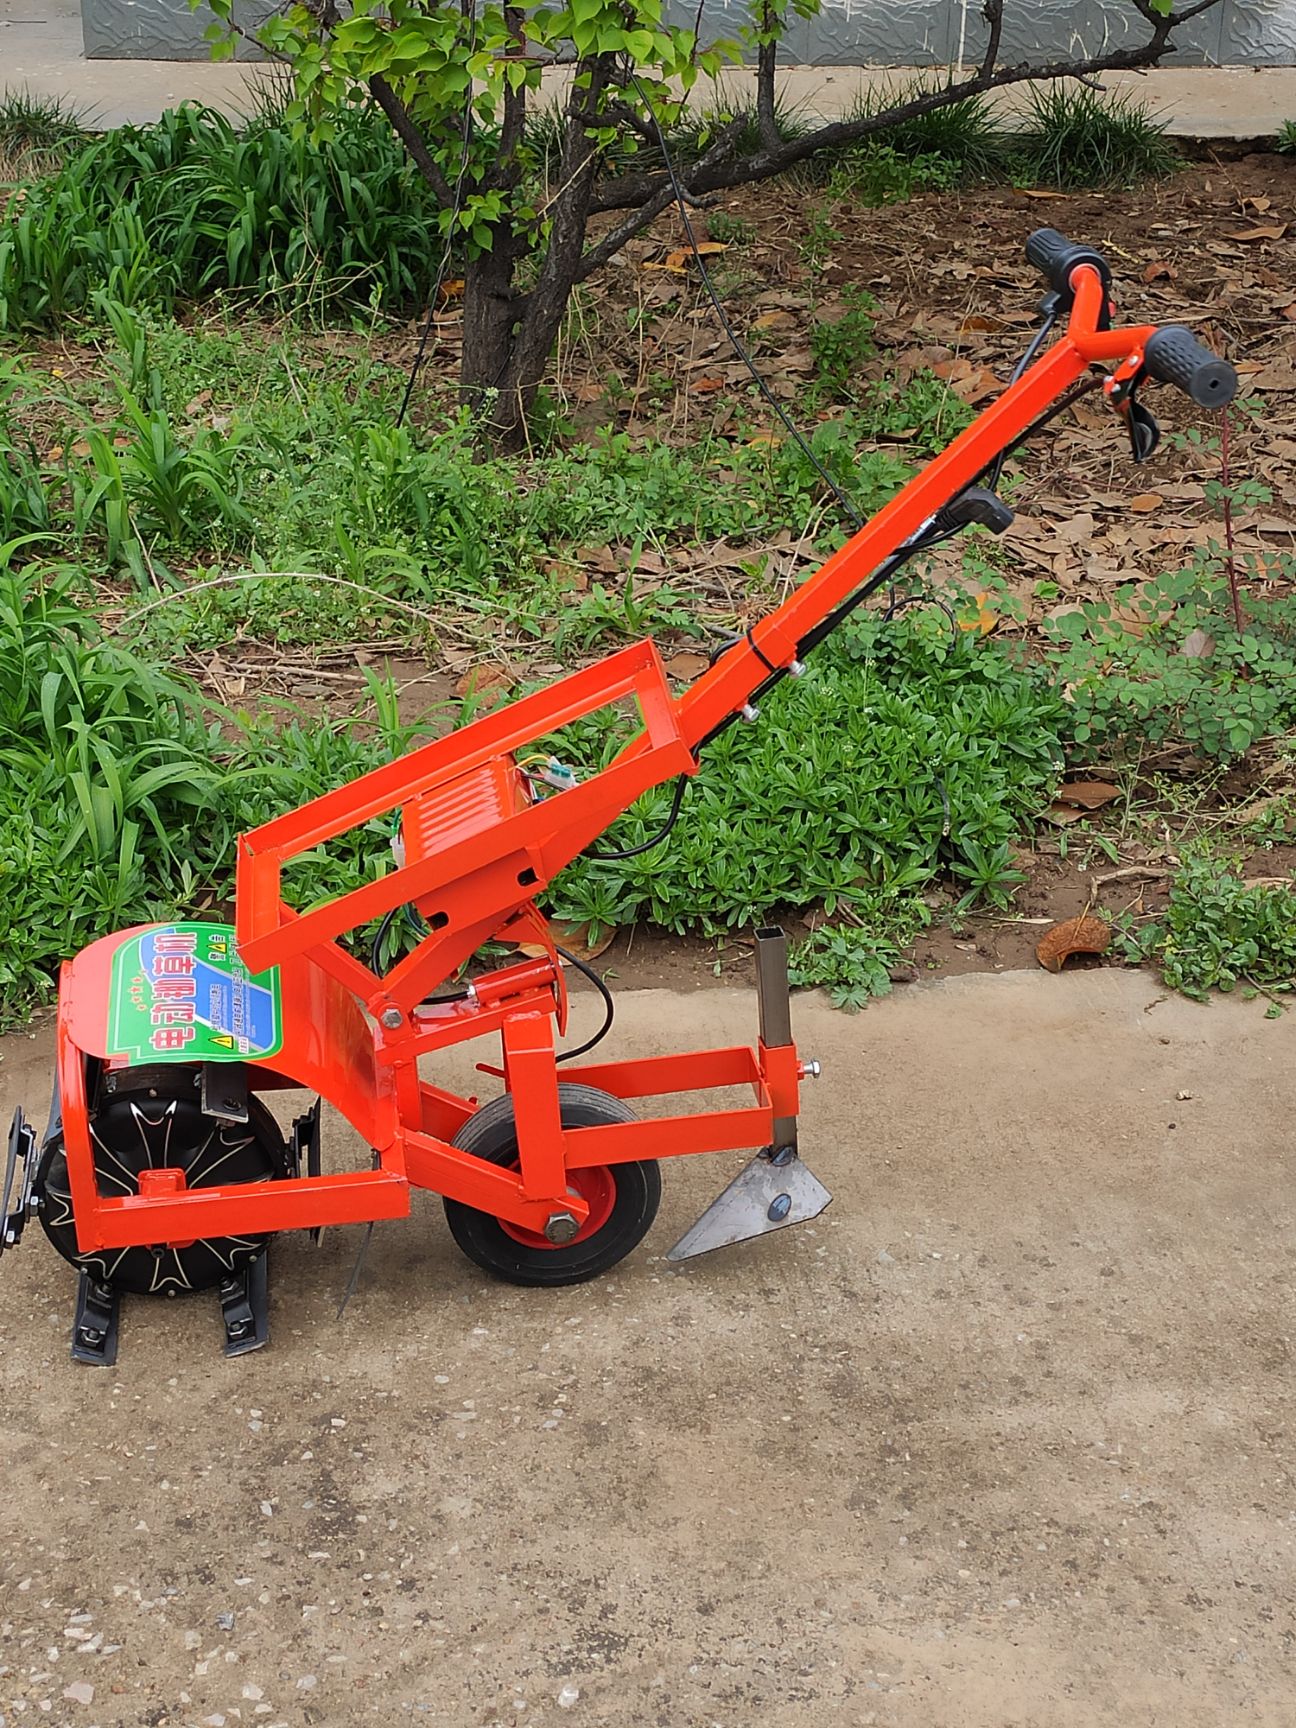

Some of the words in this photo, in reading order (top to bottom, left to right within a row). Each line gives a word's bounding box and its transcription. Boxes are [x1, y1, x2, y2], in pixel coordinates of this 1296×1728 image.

[151, 933, 196, 1050] 电动锄草机
